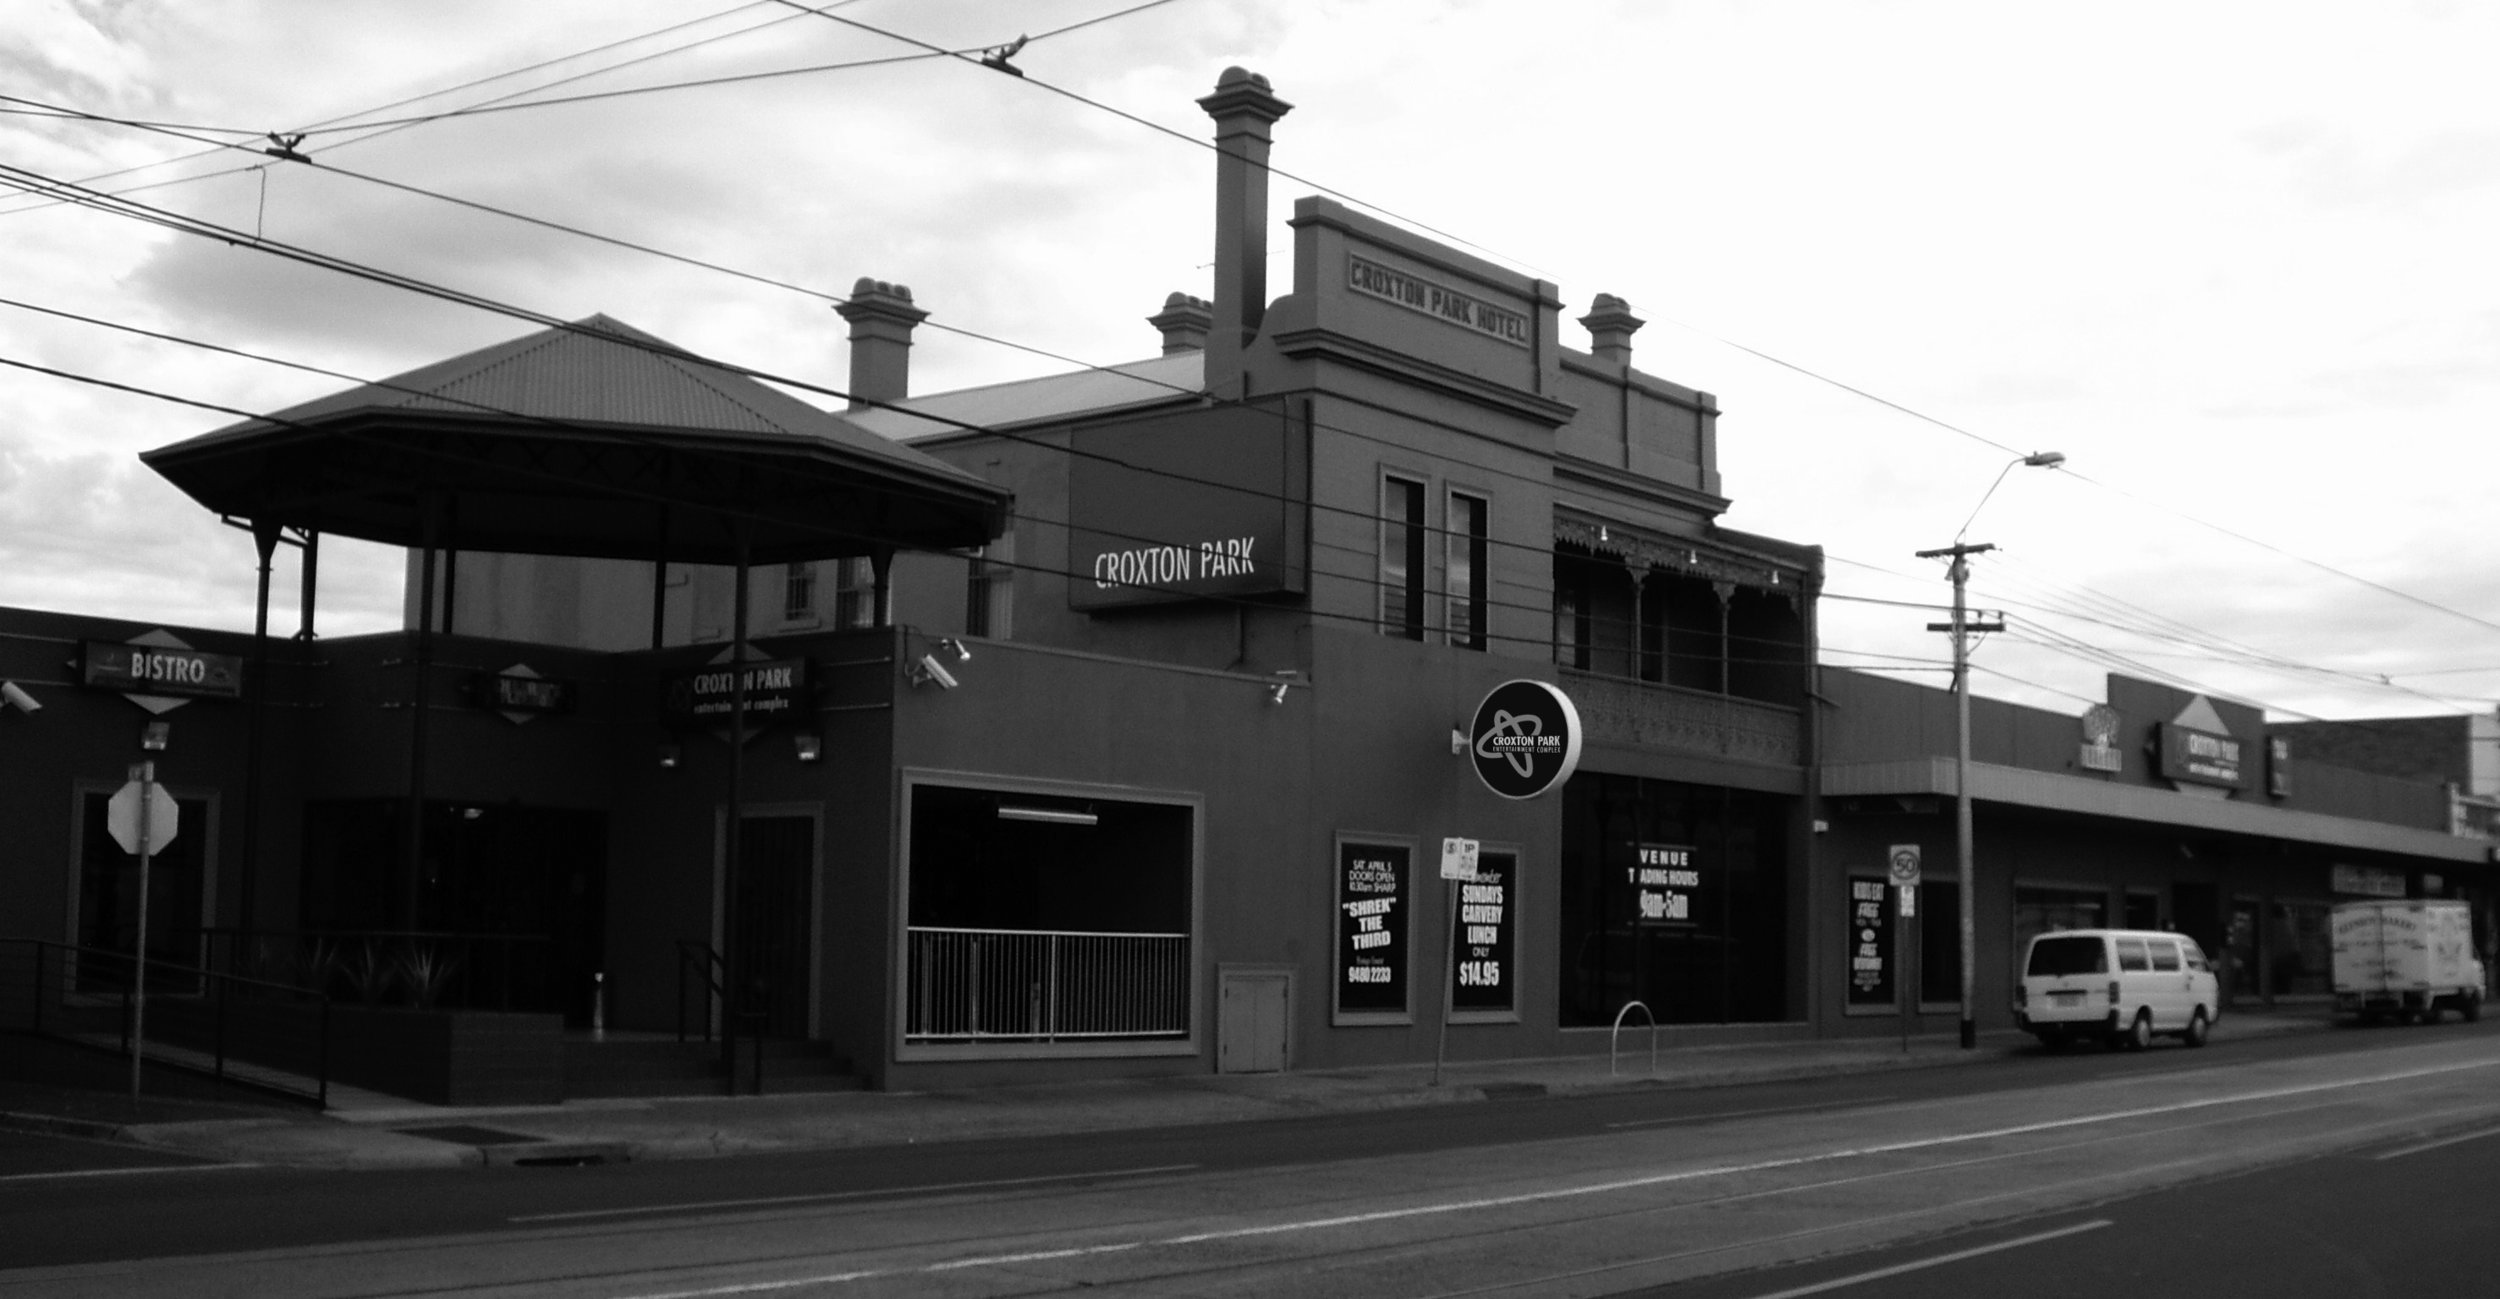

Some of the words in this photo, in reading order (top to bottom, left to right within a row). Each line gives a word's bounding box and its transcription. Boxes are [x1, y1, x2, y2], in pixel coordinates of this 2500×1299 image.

[1350, 262, 1426, 309] CROXTON
[1430, 288, 1472, 325] PARK
[1477, 305, 1528, 341] HOTEL
[1095, 545, 1190, 589] CROXTON
[1201, 536, 1255, 579] PARK
[131, 652, 206, 684] BISTRO
[694, 672, 753, 695] CROXTN
[757, 667, 791, 690] PARK
[1493, 736, 1535, 747] CROXTON
[1538, 735, 1561, 747] PARK
[1537, 746, 1561, 754] COMPLEX
[1640, 849, 1688, 866] VENUE
[1896, 859, 1915, 873] 50
[1349, 870, 1374, 882] DOORS
[1375, 872, 1396, 884] OPEN
[1628, 867, 1668, 885] TADING
[1669, 869, 1699, 887] HOURS
[1374, 883, 1396, 893] SHARP
[1462, 884, 1503, 904] SUNDAYS
[1872, 883, 1884, 901] EAT
[1342, 897, 1397, 918] "SHREK"
[1462, 904, 1503, 924] CARVERY
[1640, 889, 1688, 919] 9am-5am
[1358, 915, 1383, 932] THE
[1351, 930, 1391, 950] THIRD
[1467, 925, 1497, 945] LUNCH
[1459, 961, 1500, 987] $14.95
